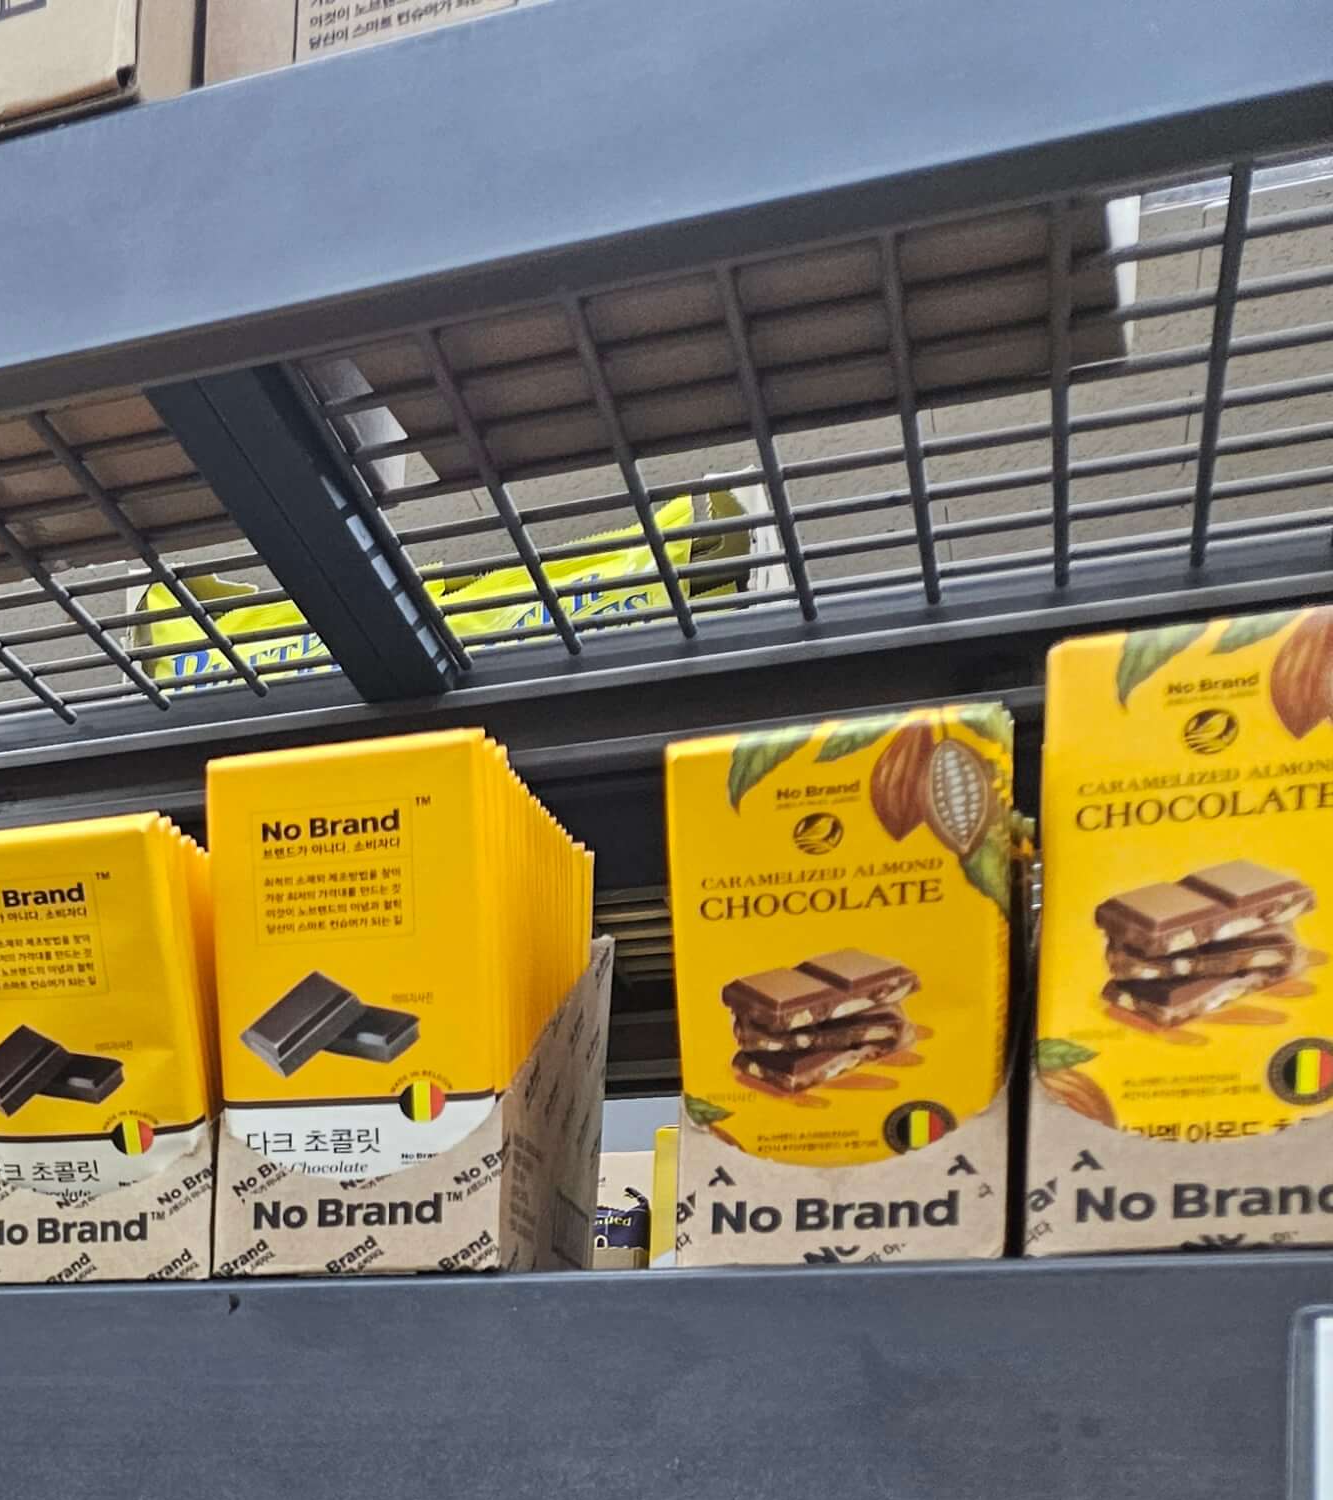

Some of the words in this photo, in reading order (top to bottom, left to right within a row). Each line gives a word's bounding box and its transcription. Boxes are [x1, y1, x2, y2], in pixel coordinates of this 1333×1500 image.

[777, 788, 802, 801] No
[807, 780, 860, 798] Brand
[1077, 769, 1240, 797] CARAMELIZED
[1248, 758, 1333, 779] ALMON
[261, 820, 302, 842] No
[309, 809, 400, 838] Brand
[263, 846, 308, 860] 브랜드가
[354, 837, 400, 852] 소비자다
[701, 866, 847, 890] CARAMELIZED
[855, 857, 943, 876] ALMOND
[700, 879, 944, 922] CHOCOLATE
[246, 1130, 301, 1156] 다크
[308, 1128, 381, 1156] 초콜릿
[252, 1201, 308, 1230] No
[316, 1192, 443, 1228] Brand
[711, 1198, 782, 1235] No
[795, 1190, 960, 1231] Brand
